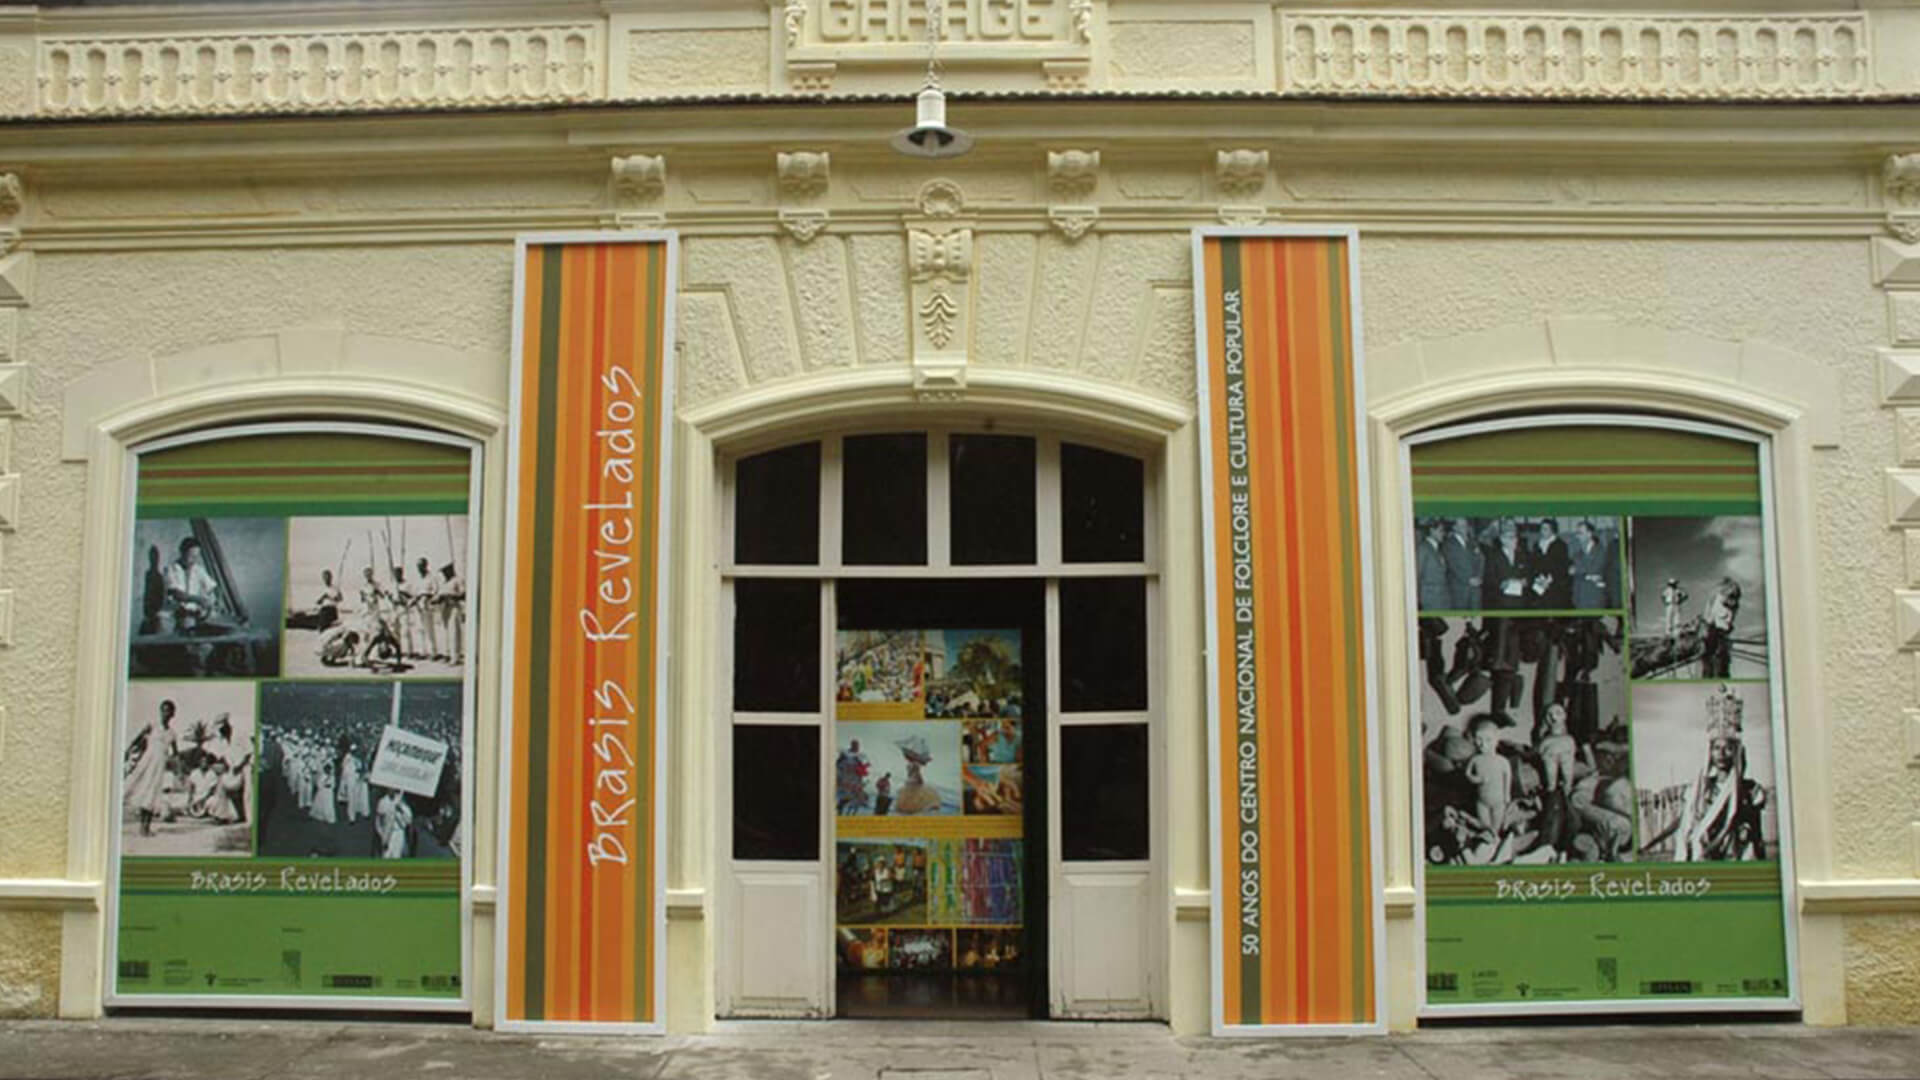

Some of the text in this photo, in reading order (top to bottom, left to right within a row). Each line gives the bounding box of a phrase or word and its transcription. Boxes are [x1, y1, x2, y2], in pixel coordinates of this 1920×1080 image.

[1224, 289, 1260, 955] 50 ANOS DO CENTRO NACIONAL DE FOLCLORE E CULTURA POPULAR
